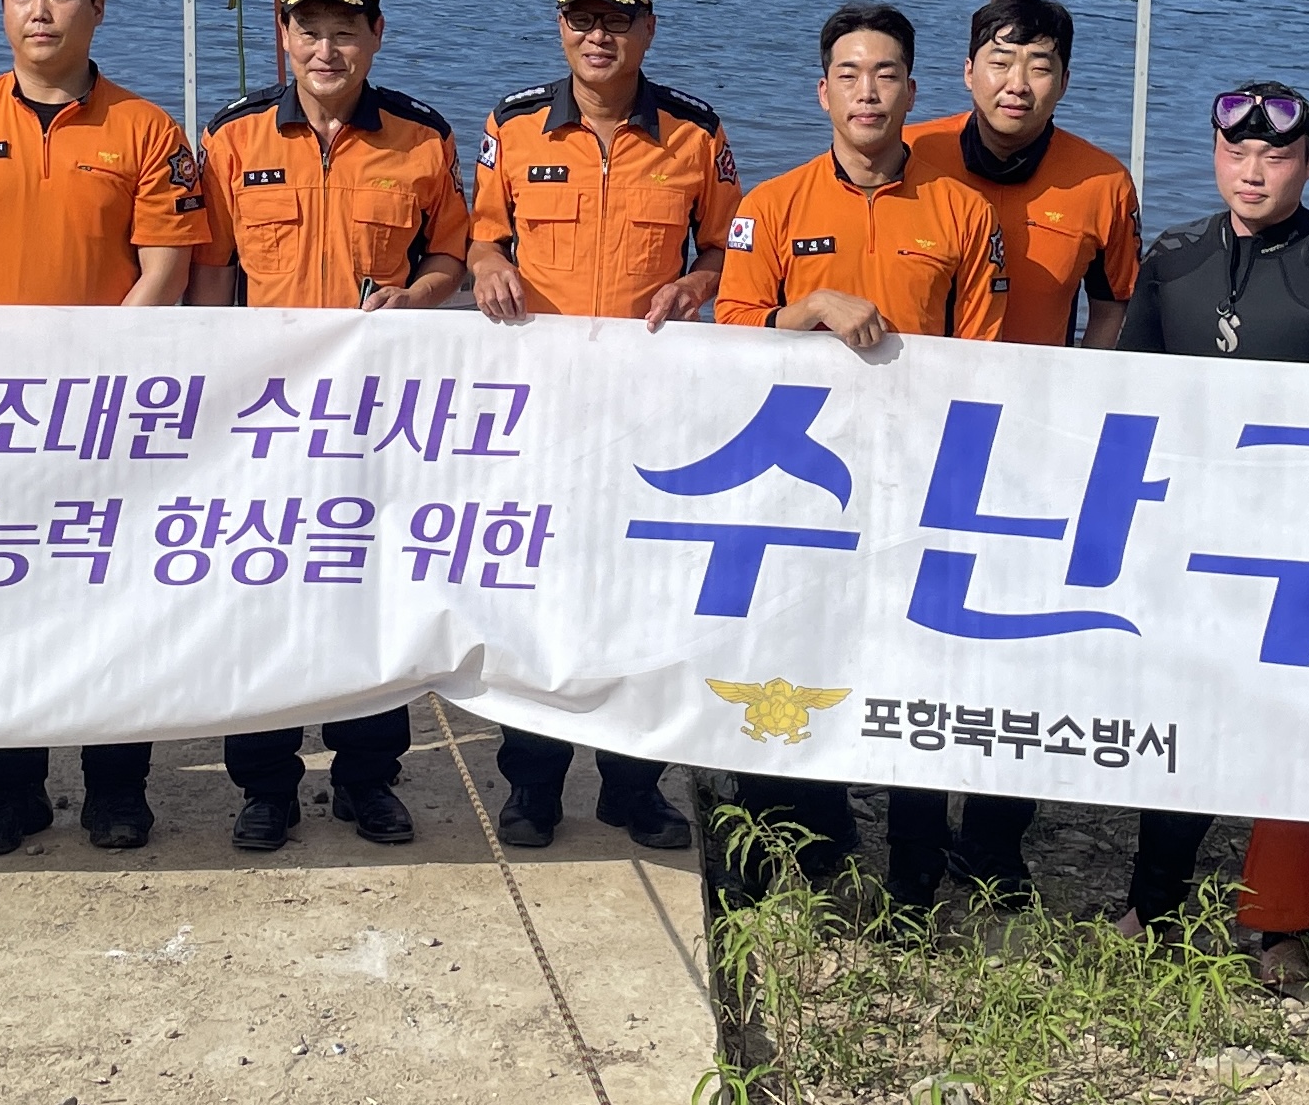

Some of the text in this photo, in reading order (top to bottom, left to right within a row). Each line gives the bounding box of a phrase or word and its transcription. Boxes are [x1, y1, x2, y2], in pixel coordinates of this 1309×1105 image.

[230, 375, 531, 463] 수난사고
[154, 496, 376, 587] 향상을
[402, 501, 554, 591] 위한
[861, 698, 1177, 774] 포항북부소방서
